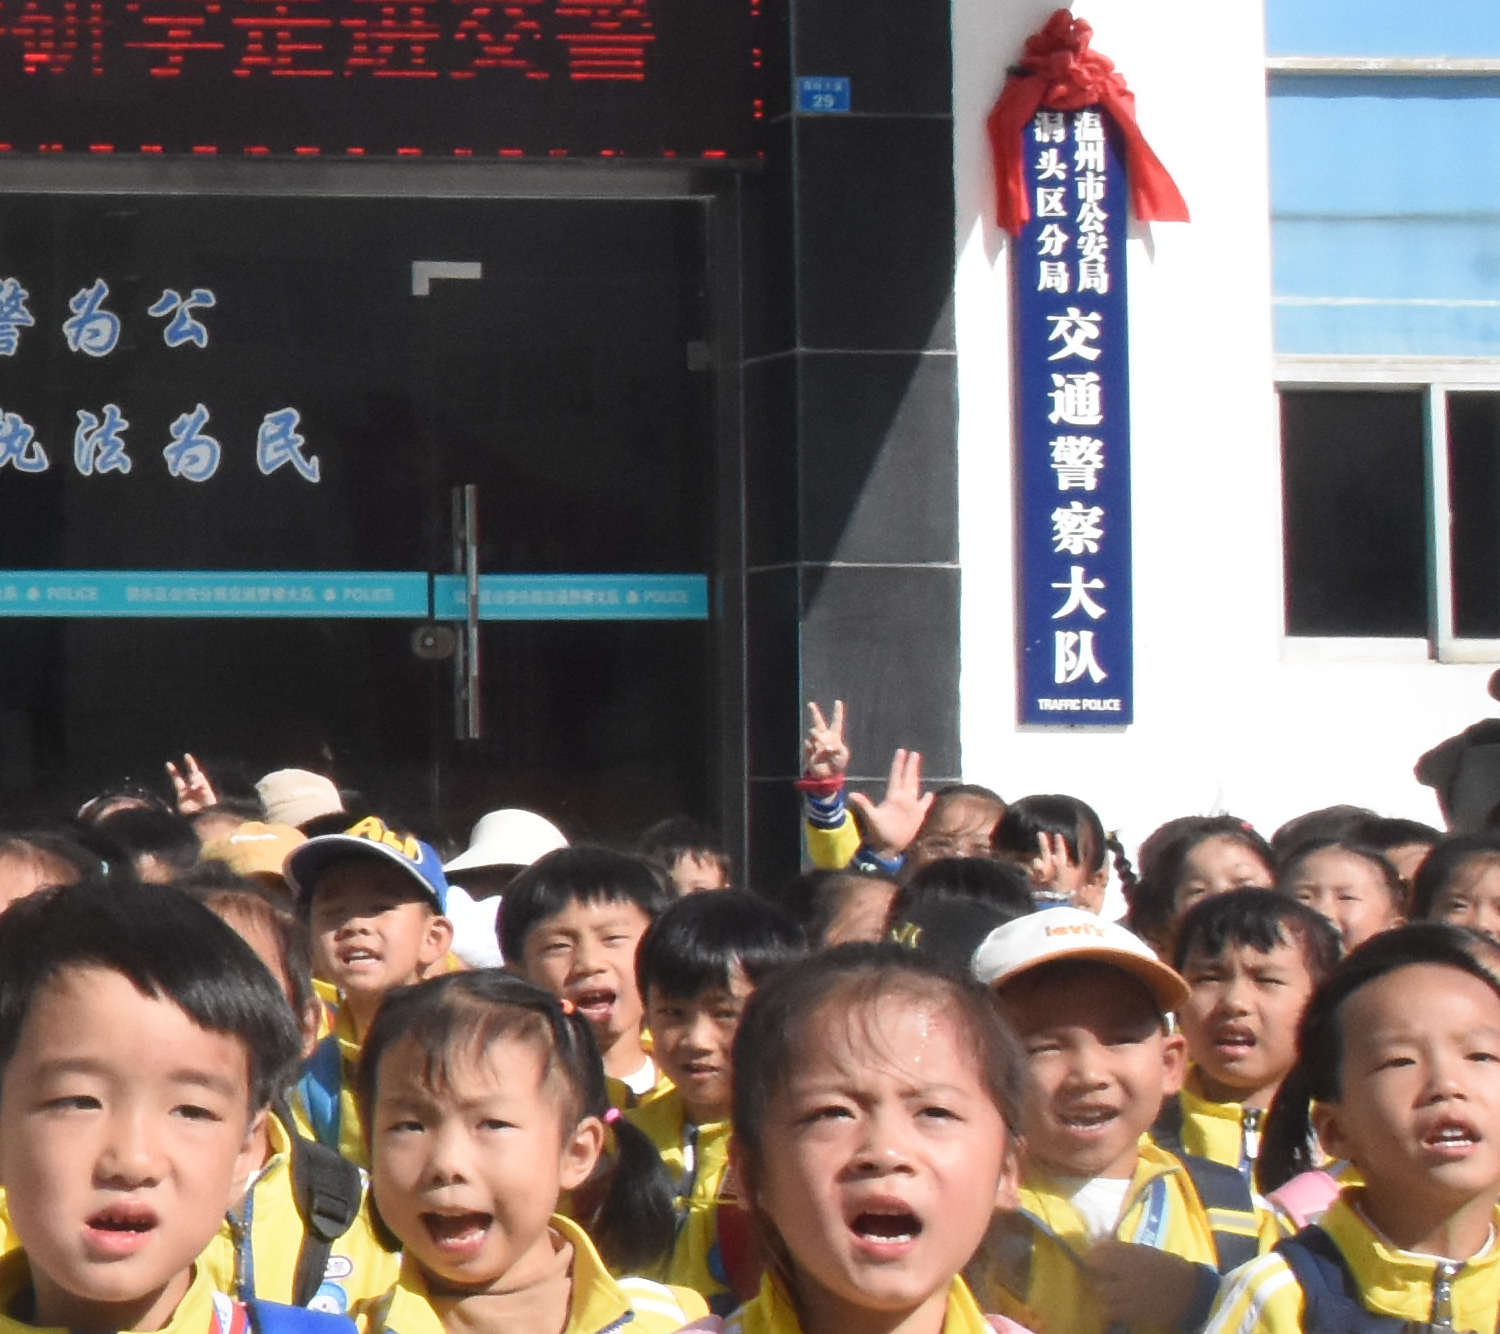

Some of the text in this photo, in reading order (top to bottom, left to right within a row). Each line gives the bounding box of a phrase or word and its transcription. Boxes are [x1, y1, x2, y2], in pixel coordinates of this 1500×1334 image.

[1033, 112, 1070, 295] 洞头区分局
[1073, 110, 1109, 295] 温州市公安局
[1046, 306, 1108, 685] 交通警察大队
[1037, 698, 1122, 712] TRAFFIC POLICE
